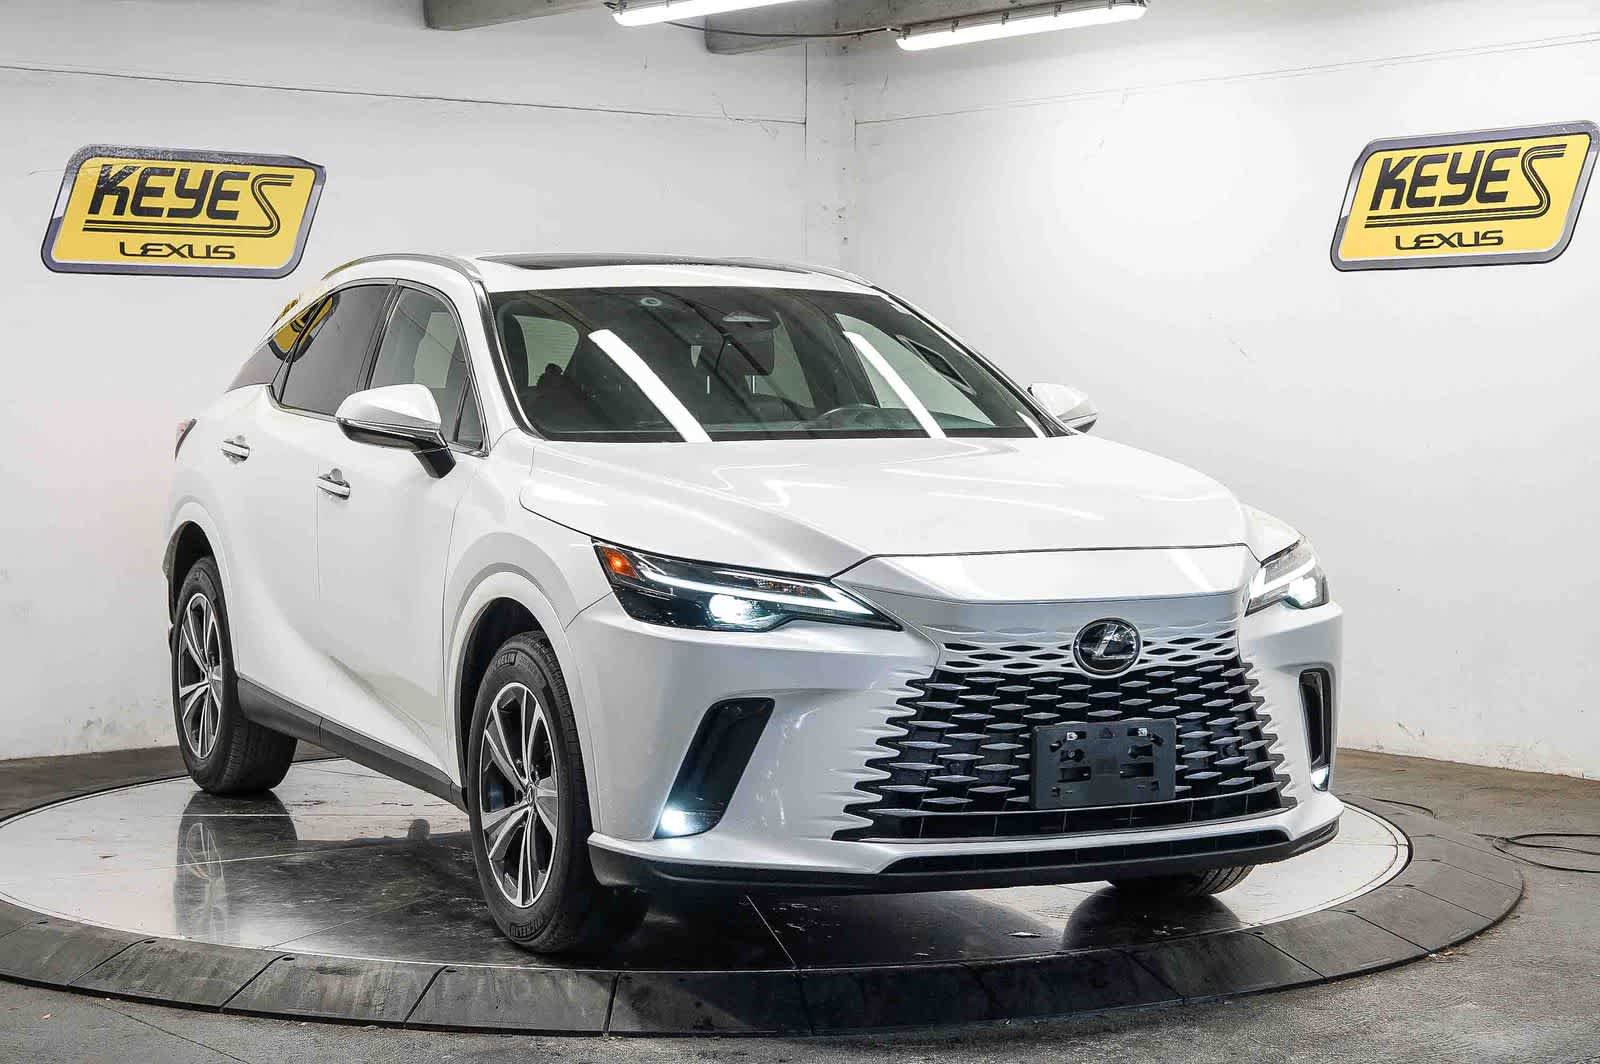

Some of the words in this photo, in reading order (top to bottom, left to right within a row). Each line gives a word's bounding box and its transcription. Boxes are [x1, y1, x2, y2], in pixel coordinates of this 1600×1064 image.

[84, 164, 294, 237] KEYES
[1365, 144, 1567, 228] KEYES
[119, 241, 236, 260] LEXUS
[1395, 229, 1503, 250] LEXUS
